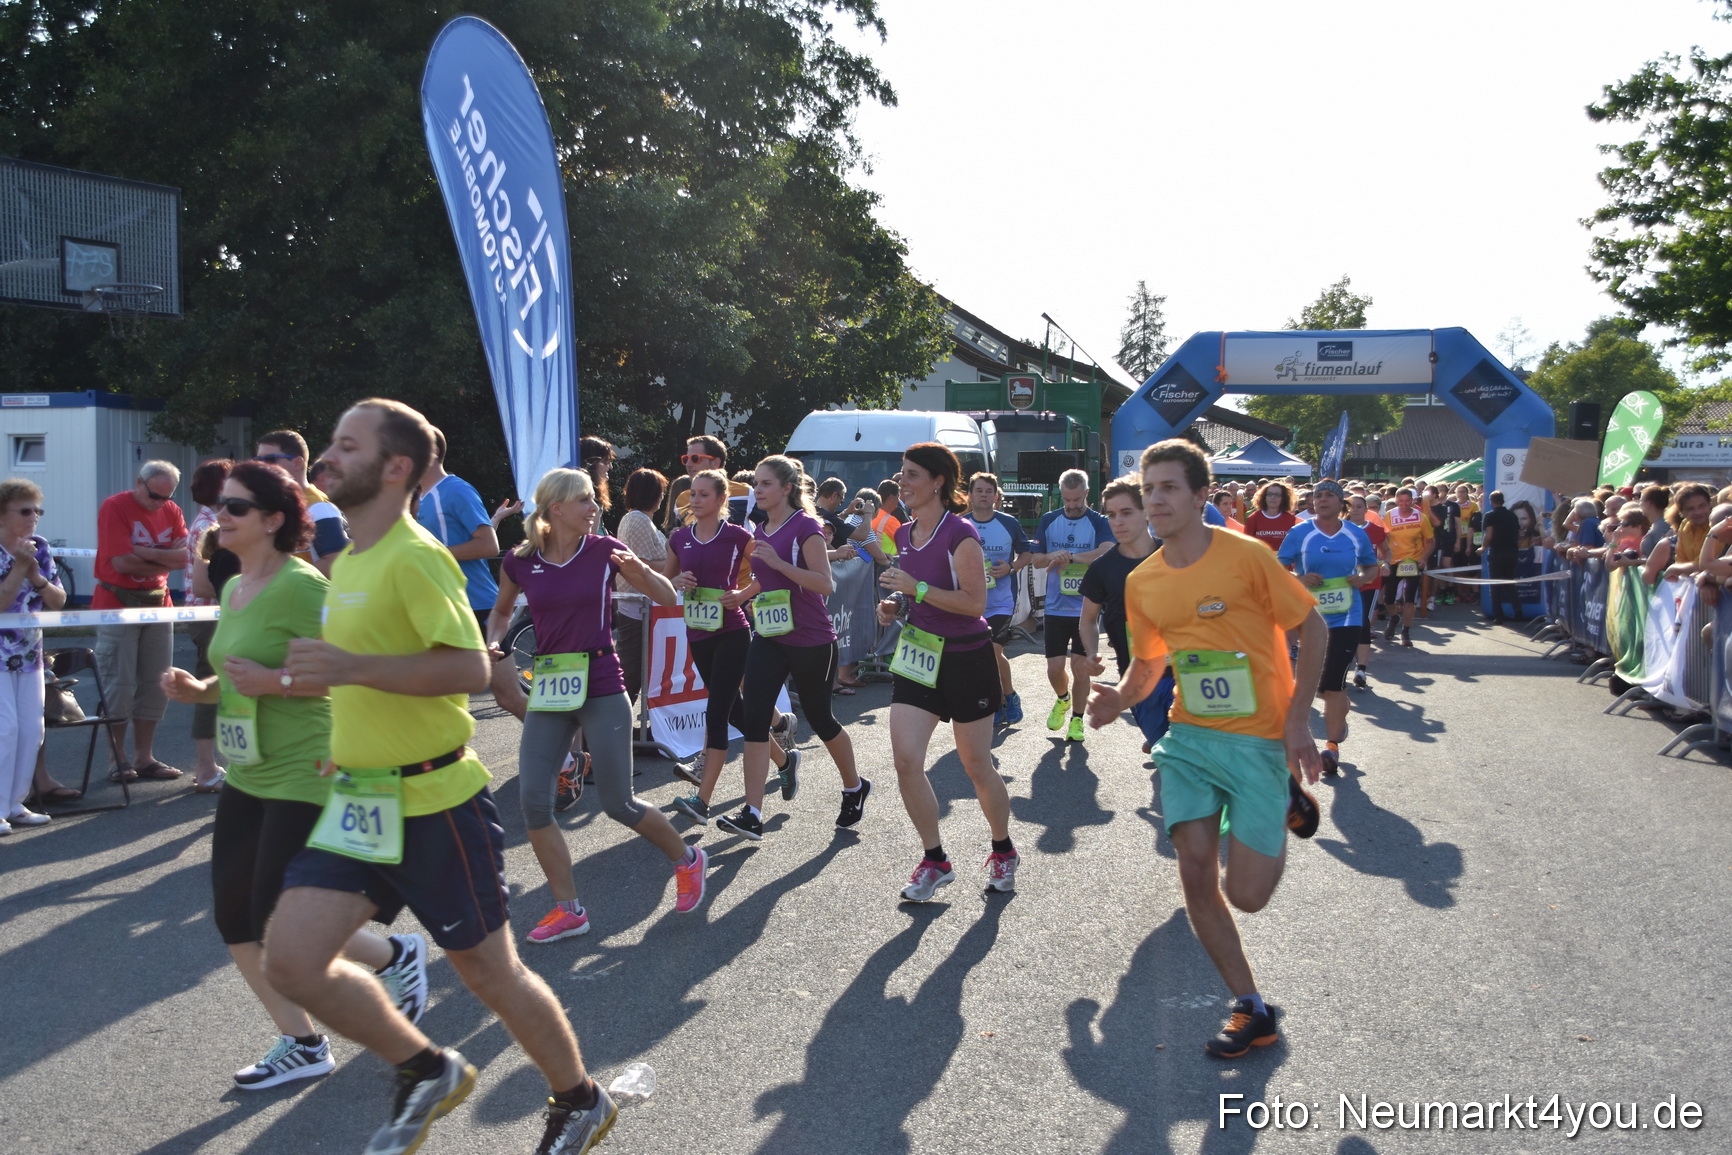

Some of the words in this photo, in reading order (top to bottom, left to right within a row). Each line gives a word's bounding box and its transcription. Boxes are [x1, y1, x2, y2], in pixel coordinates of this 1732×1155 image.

[1304, 361, 1382, 375] firmenlauf
[1159, 390, 1199, 399] Fischer
[1671, 440, 1704, 449] Jura
[1603, 445, 1630, 474] AOK
[1319, 592, 1344, 605] 554
[687, 604, 719, 619] 1112
[757, 608, 789, 624] 1108
[902, 644, 935, 672] 1110
[538, 676, 582, 696] 1109
[1200, 677, 1230, 700] 60
[220, 723, 247, 750] 518
[340, 803, 383, 835] 681
